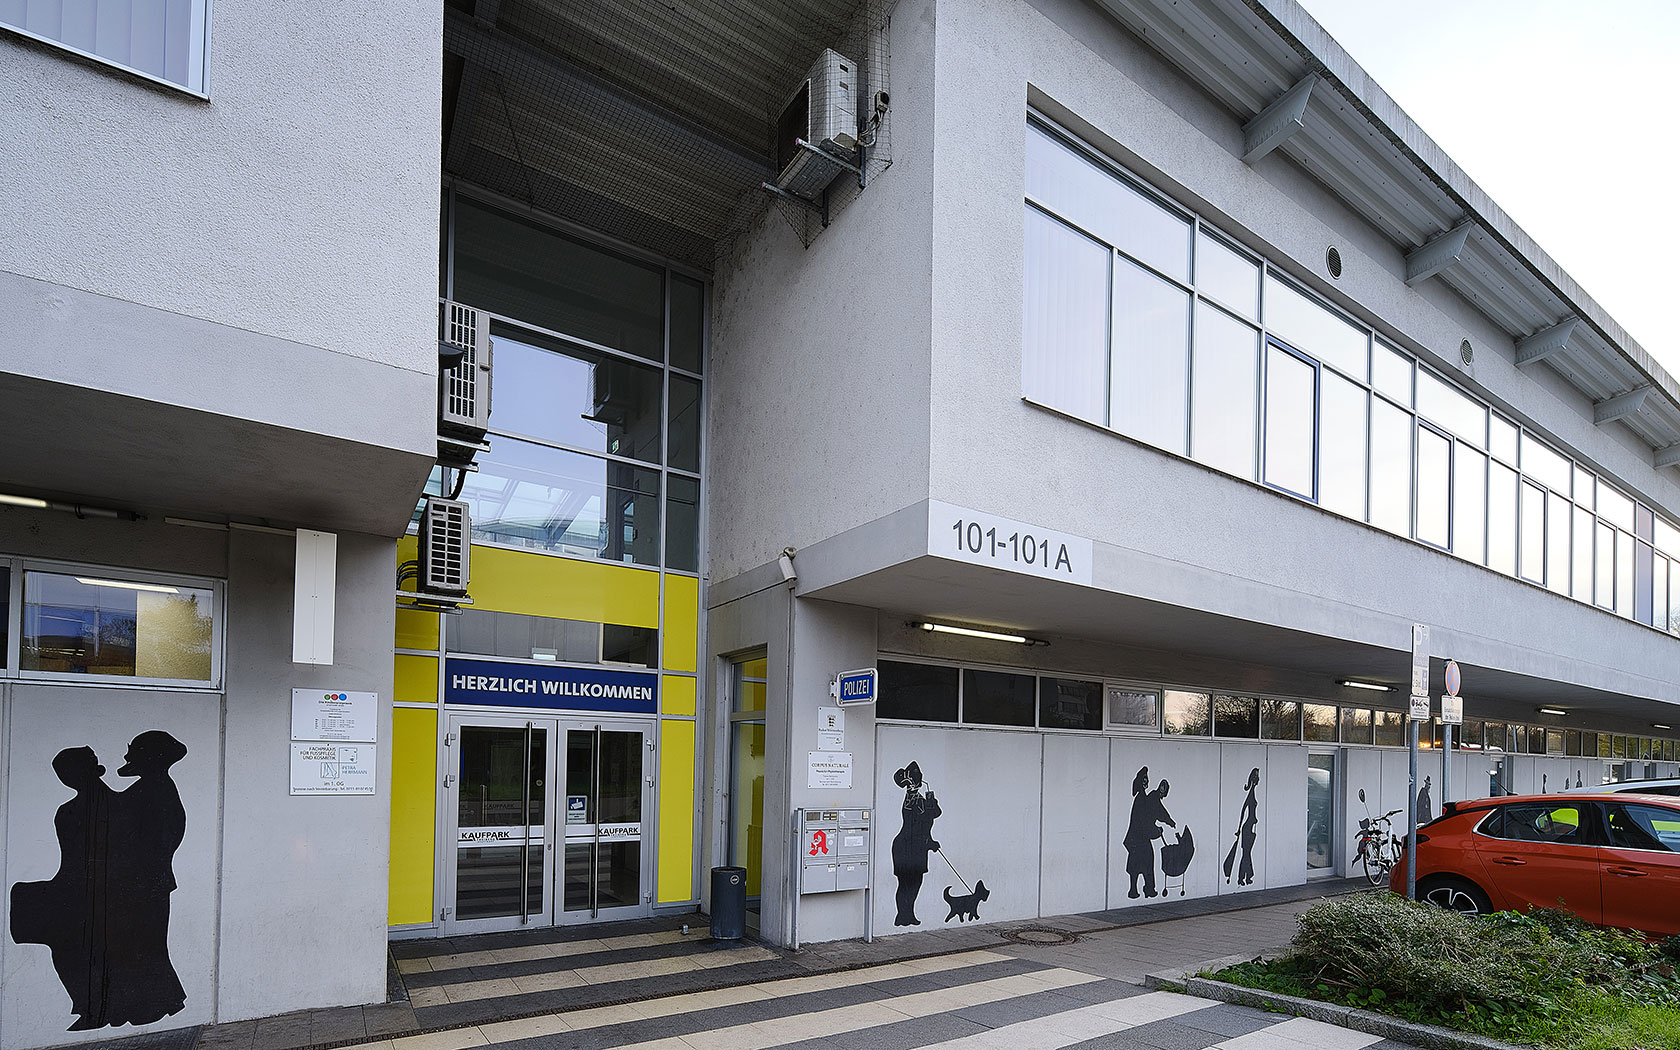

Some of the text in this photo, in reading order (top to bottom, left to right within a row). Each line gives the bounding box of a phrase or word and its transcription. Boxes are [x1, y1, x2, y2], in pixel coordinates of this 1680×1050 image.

[452, 674, 653, 701] HERZLICH WILLKOMMEN
[843, 678, 870, 697] POLIZEI
[461, 831, 510, 841] KAUFPARK
[599, 827, 639, 837] KAUFPARK
